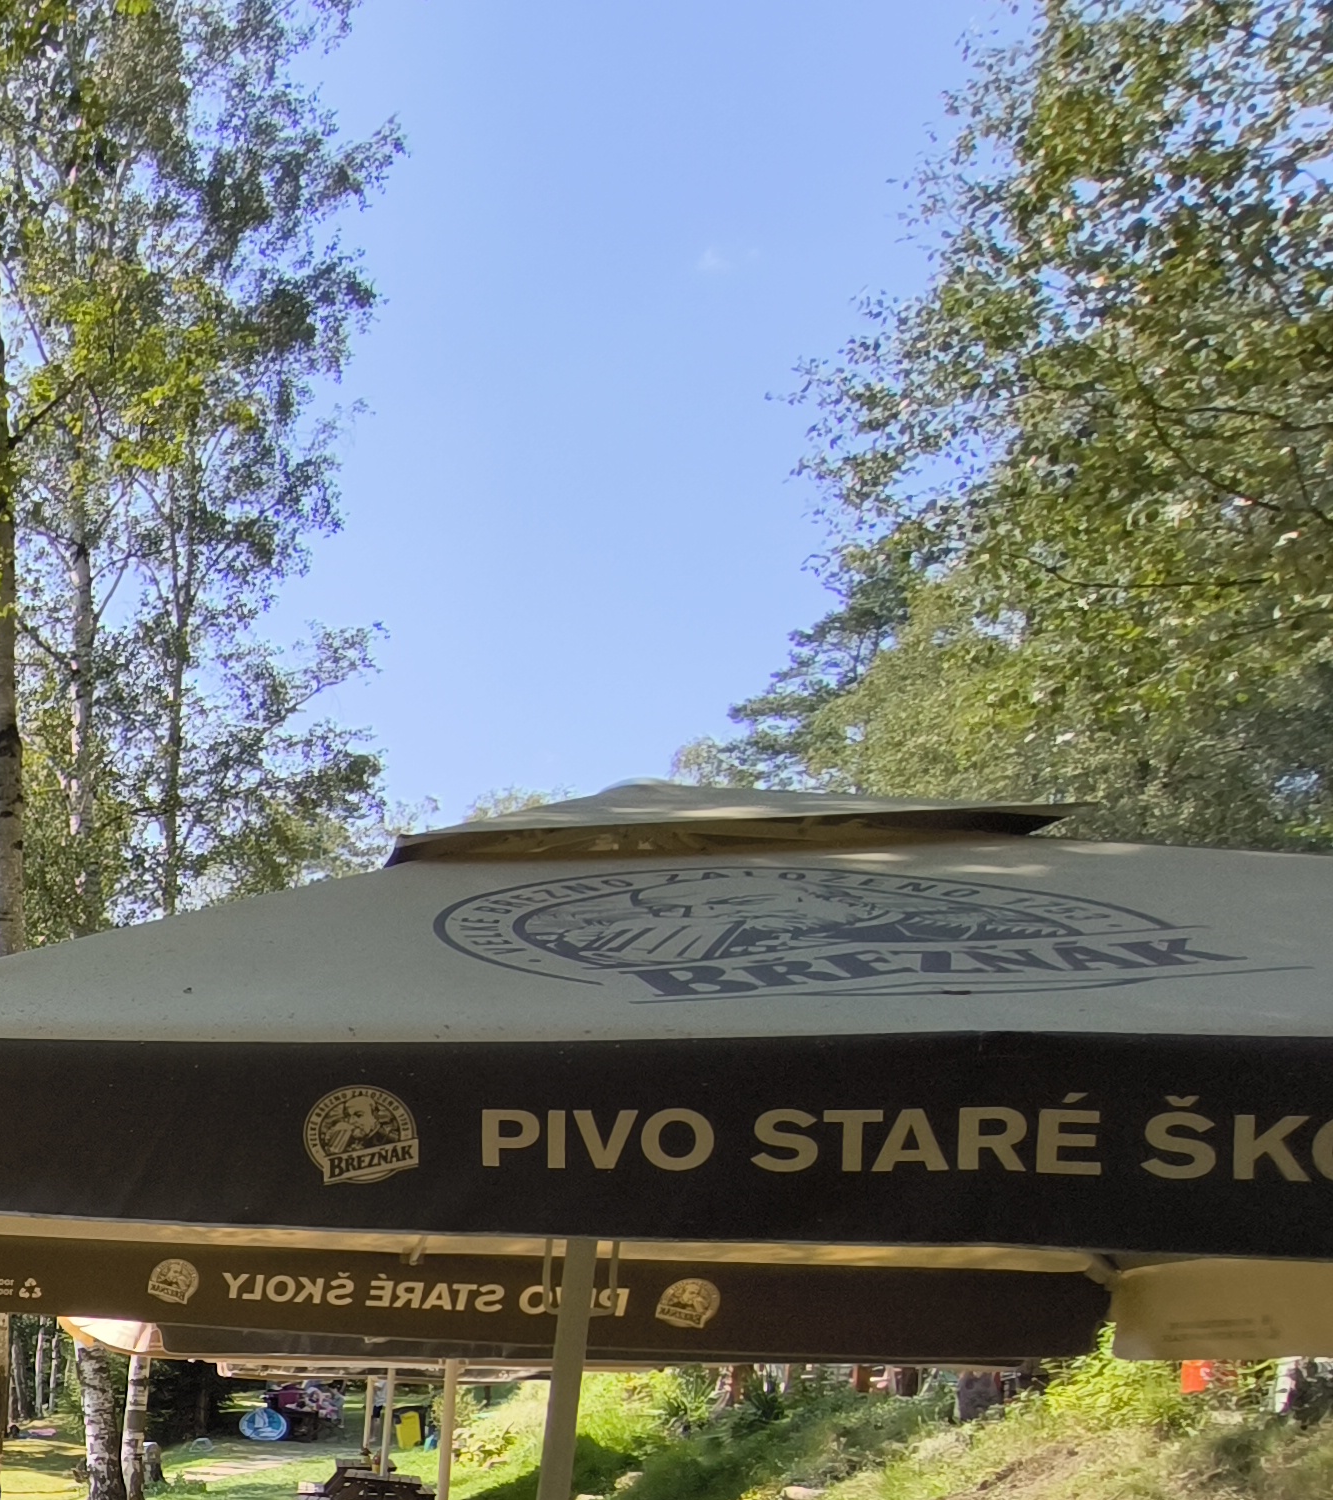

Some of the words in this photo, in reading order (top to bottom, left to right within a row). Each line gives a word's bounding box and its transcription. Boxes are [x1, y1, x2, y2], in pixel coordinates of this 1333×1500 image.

[617, 937, 1249, 998] BŘEZŇÁK
[327, 1144, 415, 1180] BŘEZŇÁK
[480, 1107, 716, 1172] PIVO
[749, 1092, 1103, 1176] STARÉ
